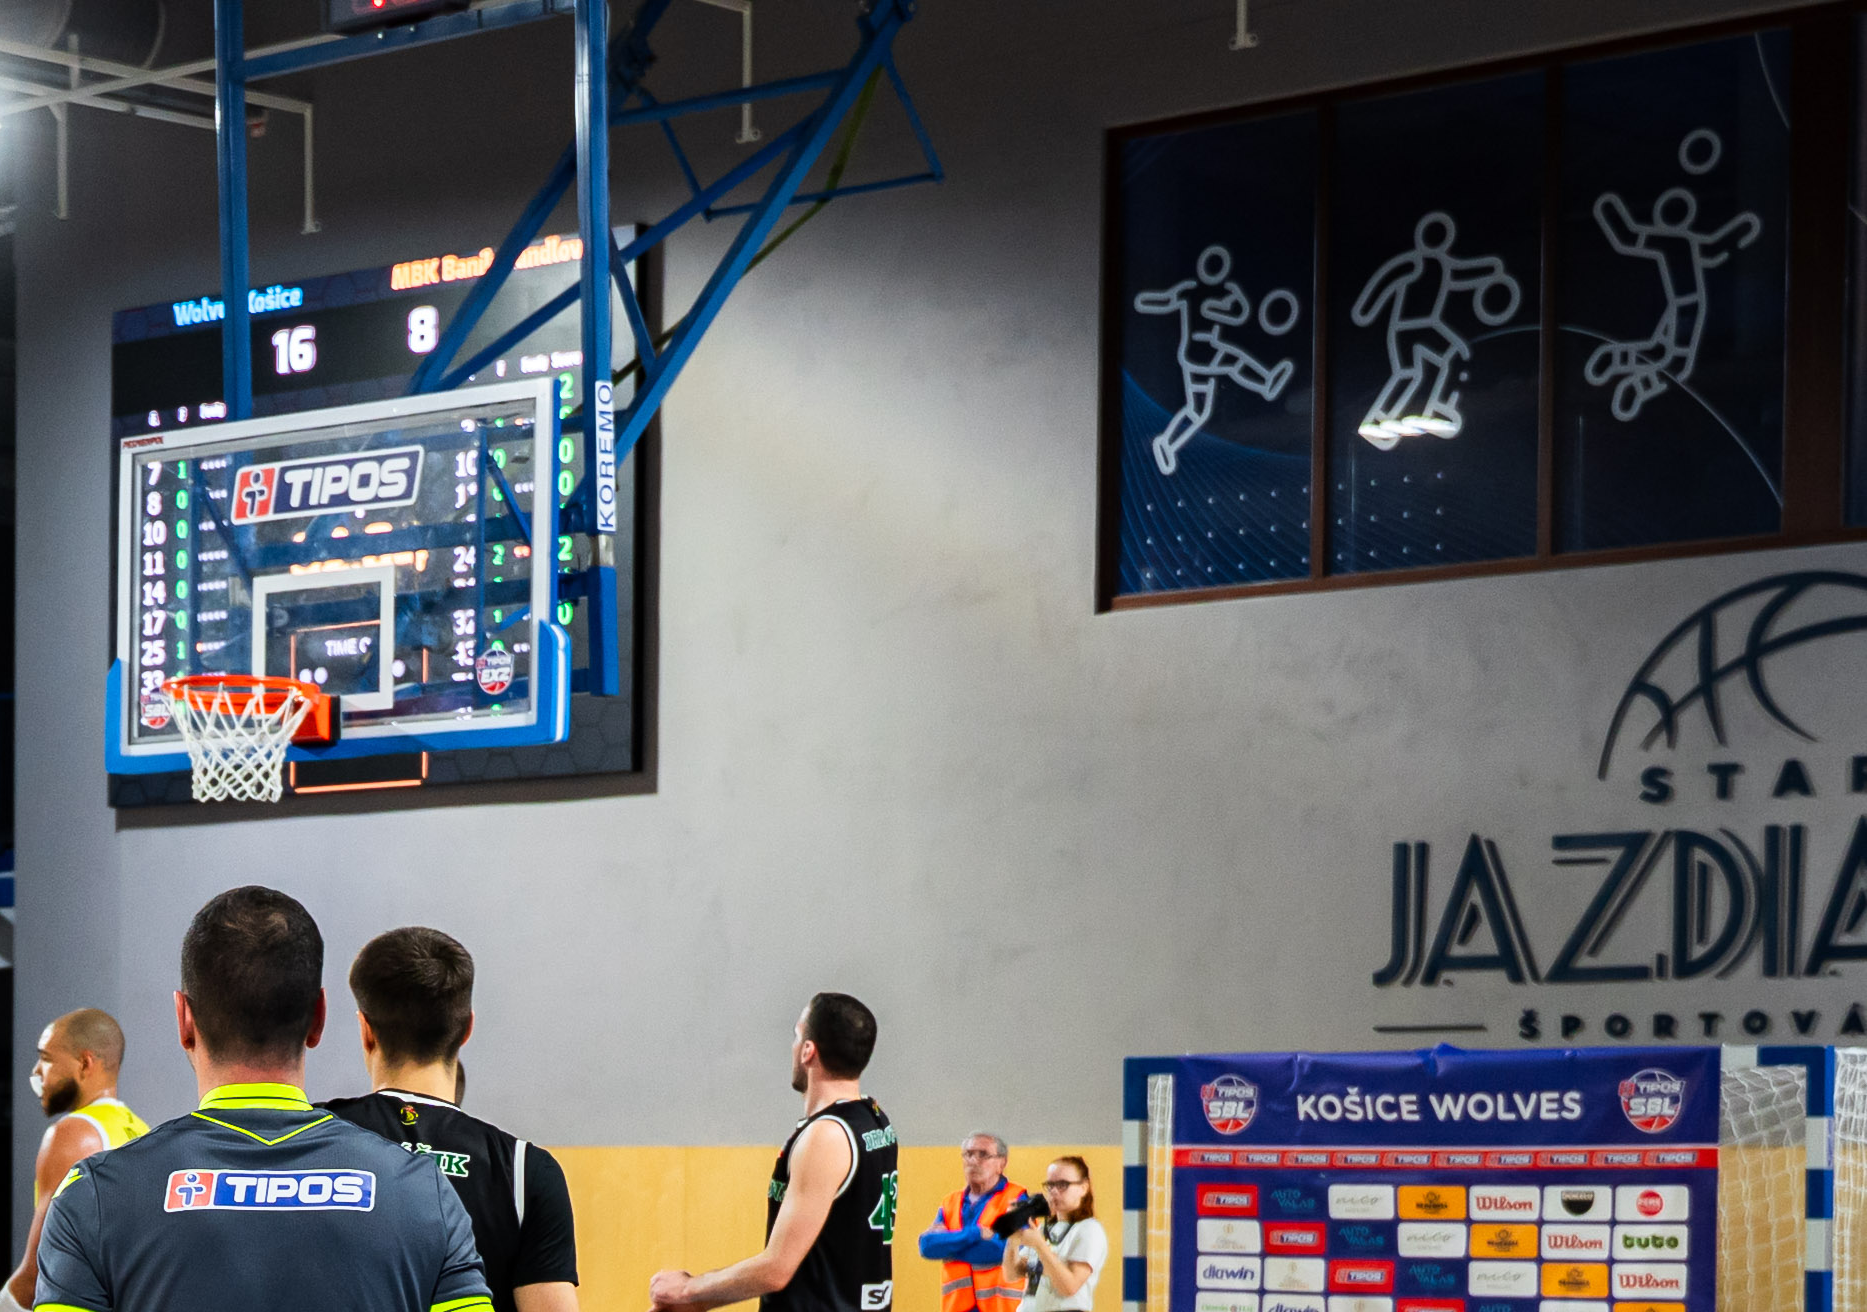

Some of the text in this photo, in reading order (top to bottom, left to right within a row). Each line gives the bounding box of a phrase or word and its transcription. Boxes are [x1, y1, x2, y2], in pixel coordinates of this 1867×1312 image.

[390, 256, 441, 291] MBK
[173, 285, 304, 327] Wolv ošice
[407, 305, 440, 355] 8
[271, 325, 317, 375] 16
[597, 384, 614, 529] KOREMO
[146, 461, 163, 486] 7
[284, 456, 410, 507] TIPOS
[146, 489, 188, 517] 8 0
[142, 519, 188, 547] 10 0
[142, 549, 188, 577] 11 0
[142, 579, 188, 607] 14 0
[142, 609, 188, 637] 17 0
[140, 639, 167, 667] 25
[1636, 1080, 1683, 1095] TIPOS
[1208, 1101, 1249, 1119] SBL
[1296, 1086, 1582, 1122] KOŠICE WOLVES
[1628, 1097, 1677, 1117] SBL
[232, 1176, 363, 1204] TIPOS
[1474, 1194, 1534, 1211] Wilson
[1546, 1233, 1604, 1250] Wilson
[1621, 1233, 1680, 1250] tuto
[1202, 1264, 1255, 1282] diawin
[1618, 1273, 1681, 1290] Wilson
